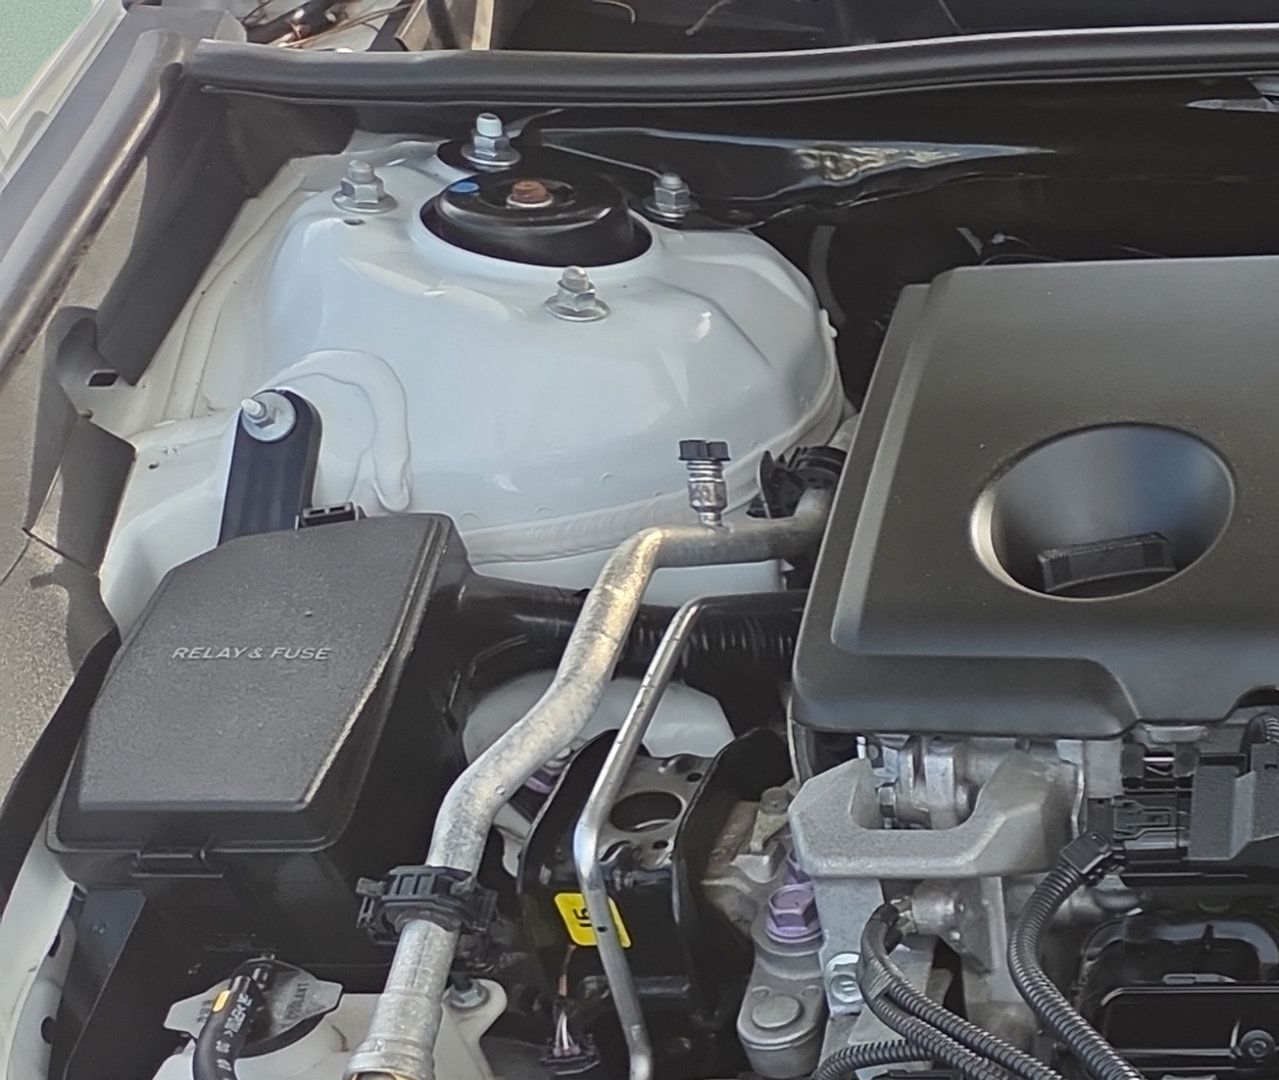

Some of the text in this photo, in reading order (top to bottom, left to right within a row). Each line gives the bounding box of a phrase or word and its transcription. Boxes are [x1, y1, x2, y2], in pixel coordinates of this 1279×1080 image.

[171, 646, 331, 660] RELAY & FUSE
